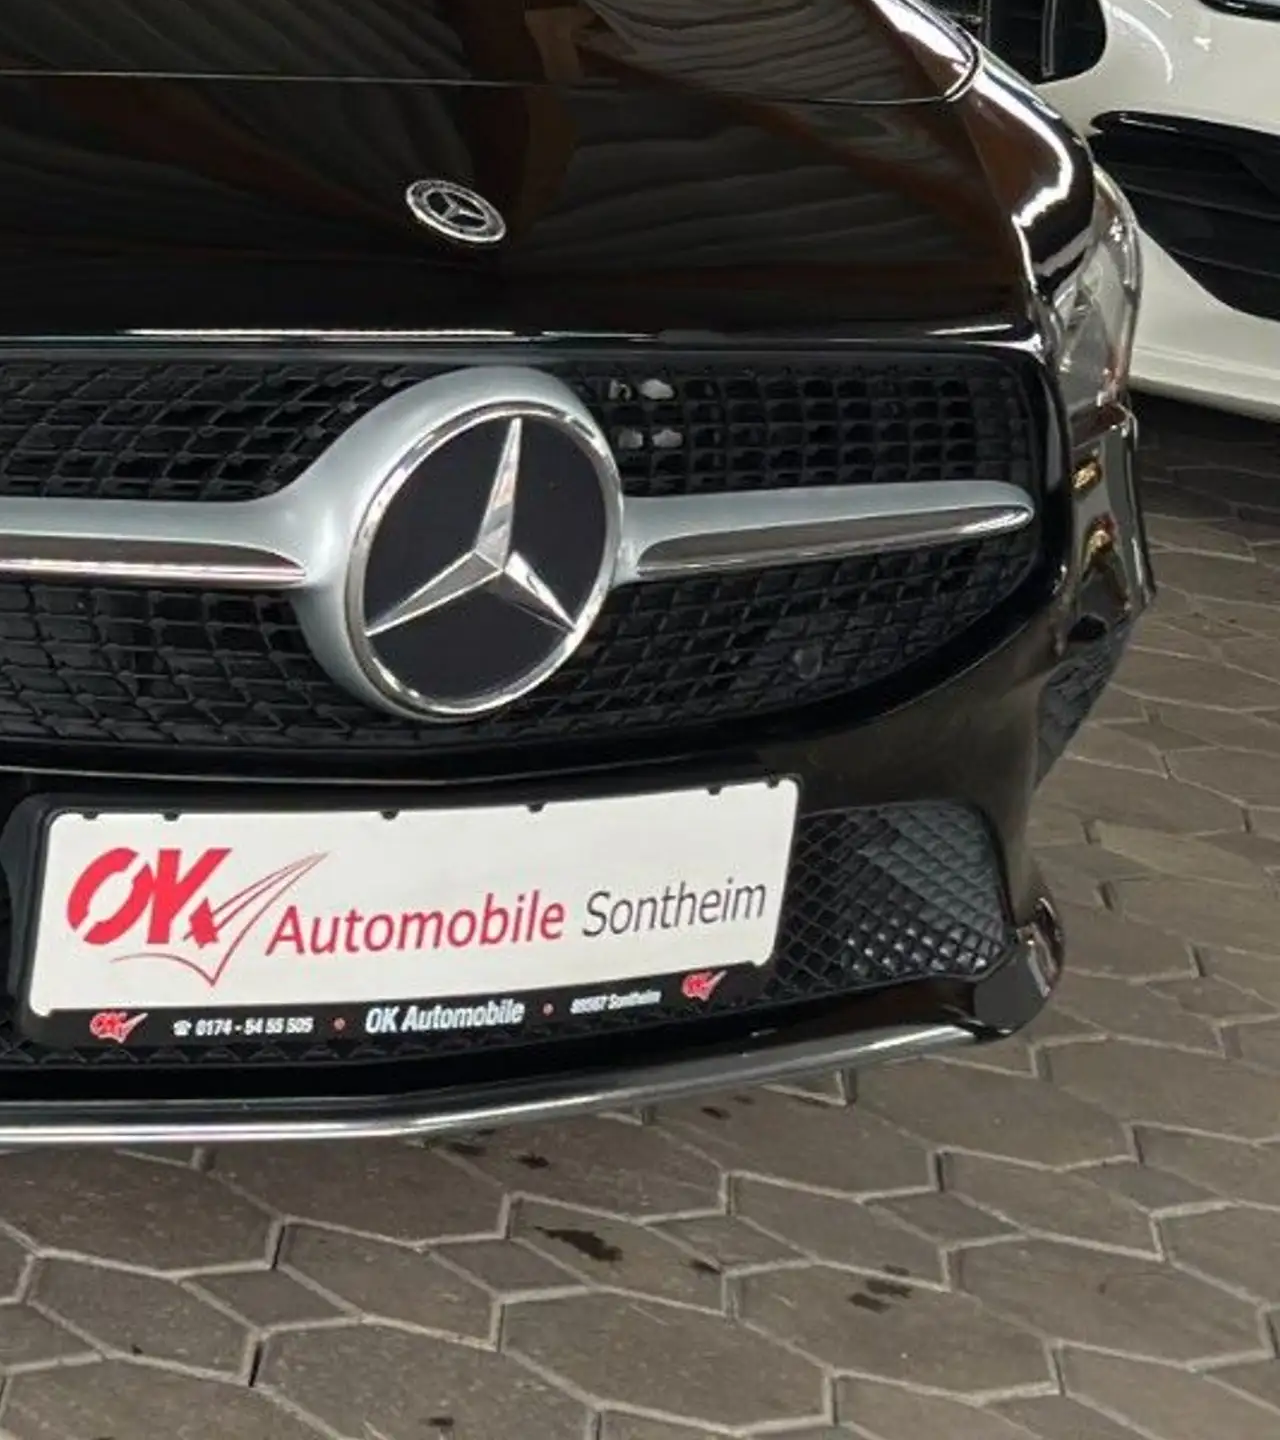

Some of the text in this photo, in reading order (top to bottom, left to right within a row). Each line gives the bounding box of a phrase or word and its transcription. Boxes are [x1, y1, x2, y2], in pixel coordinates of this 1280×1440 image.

[67, 847, 767, 957] OK Automobile Sontheim
[365, 998, 525, 1034] OK Automobile
